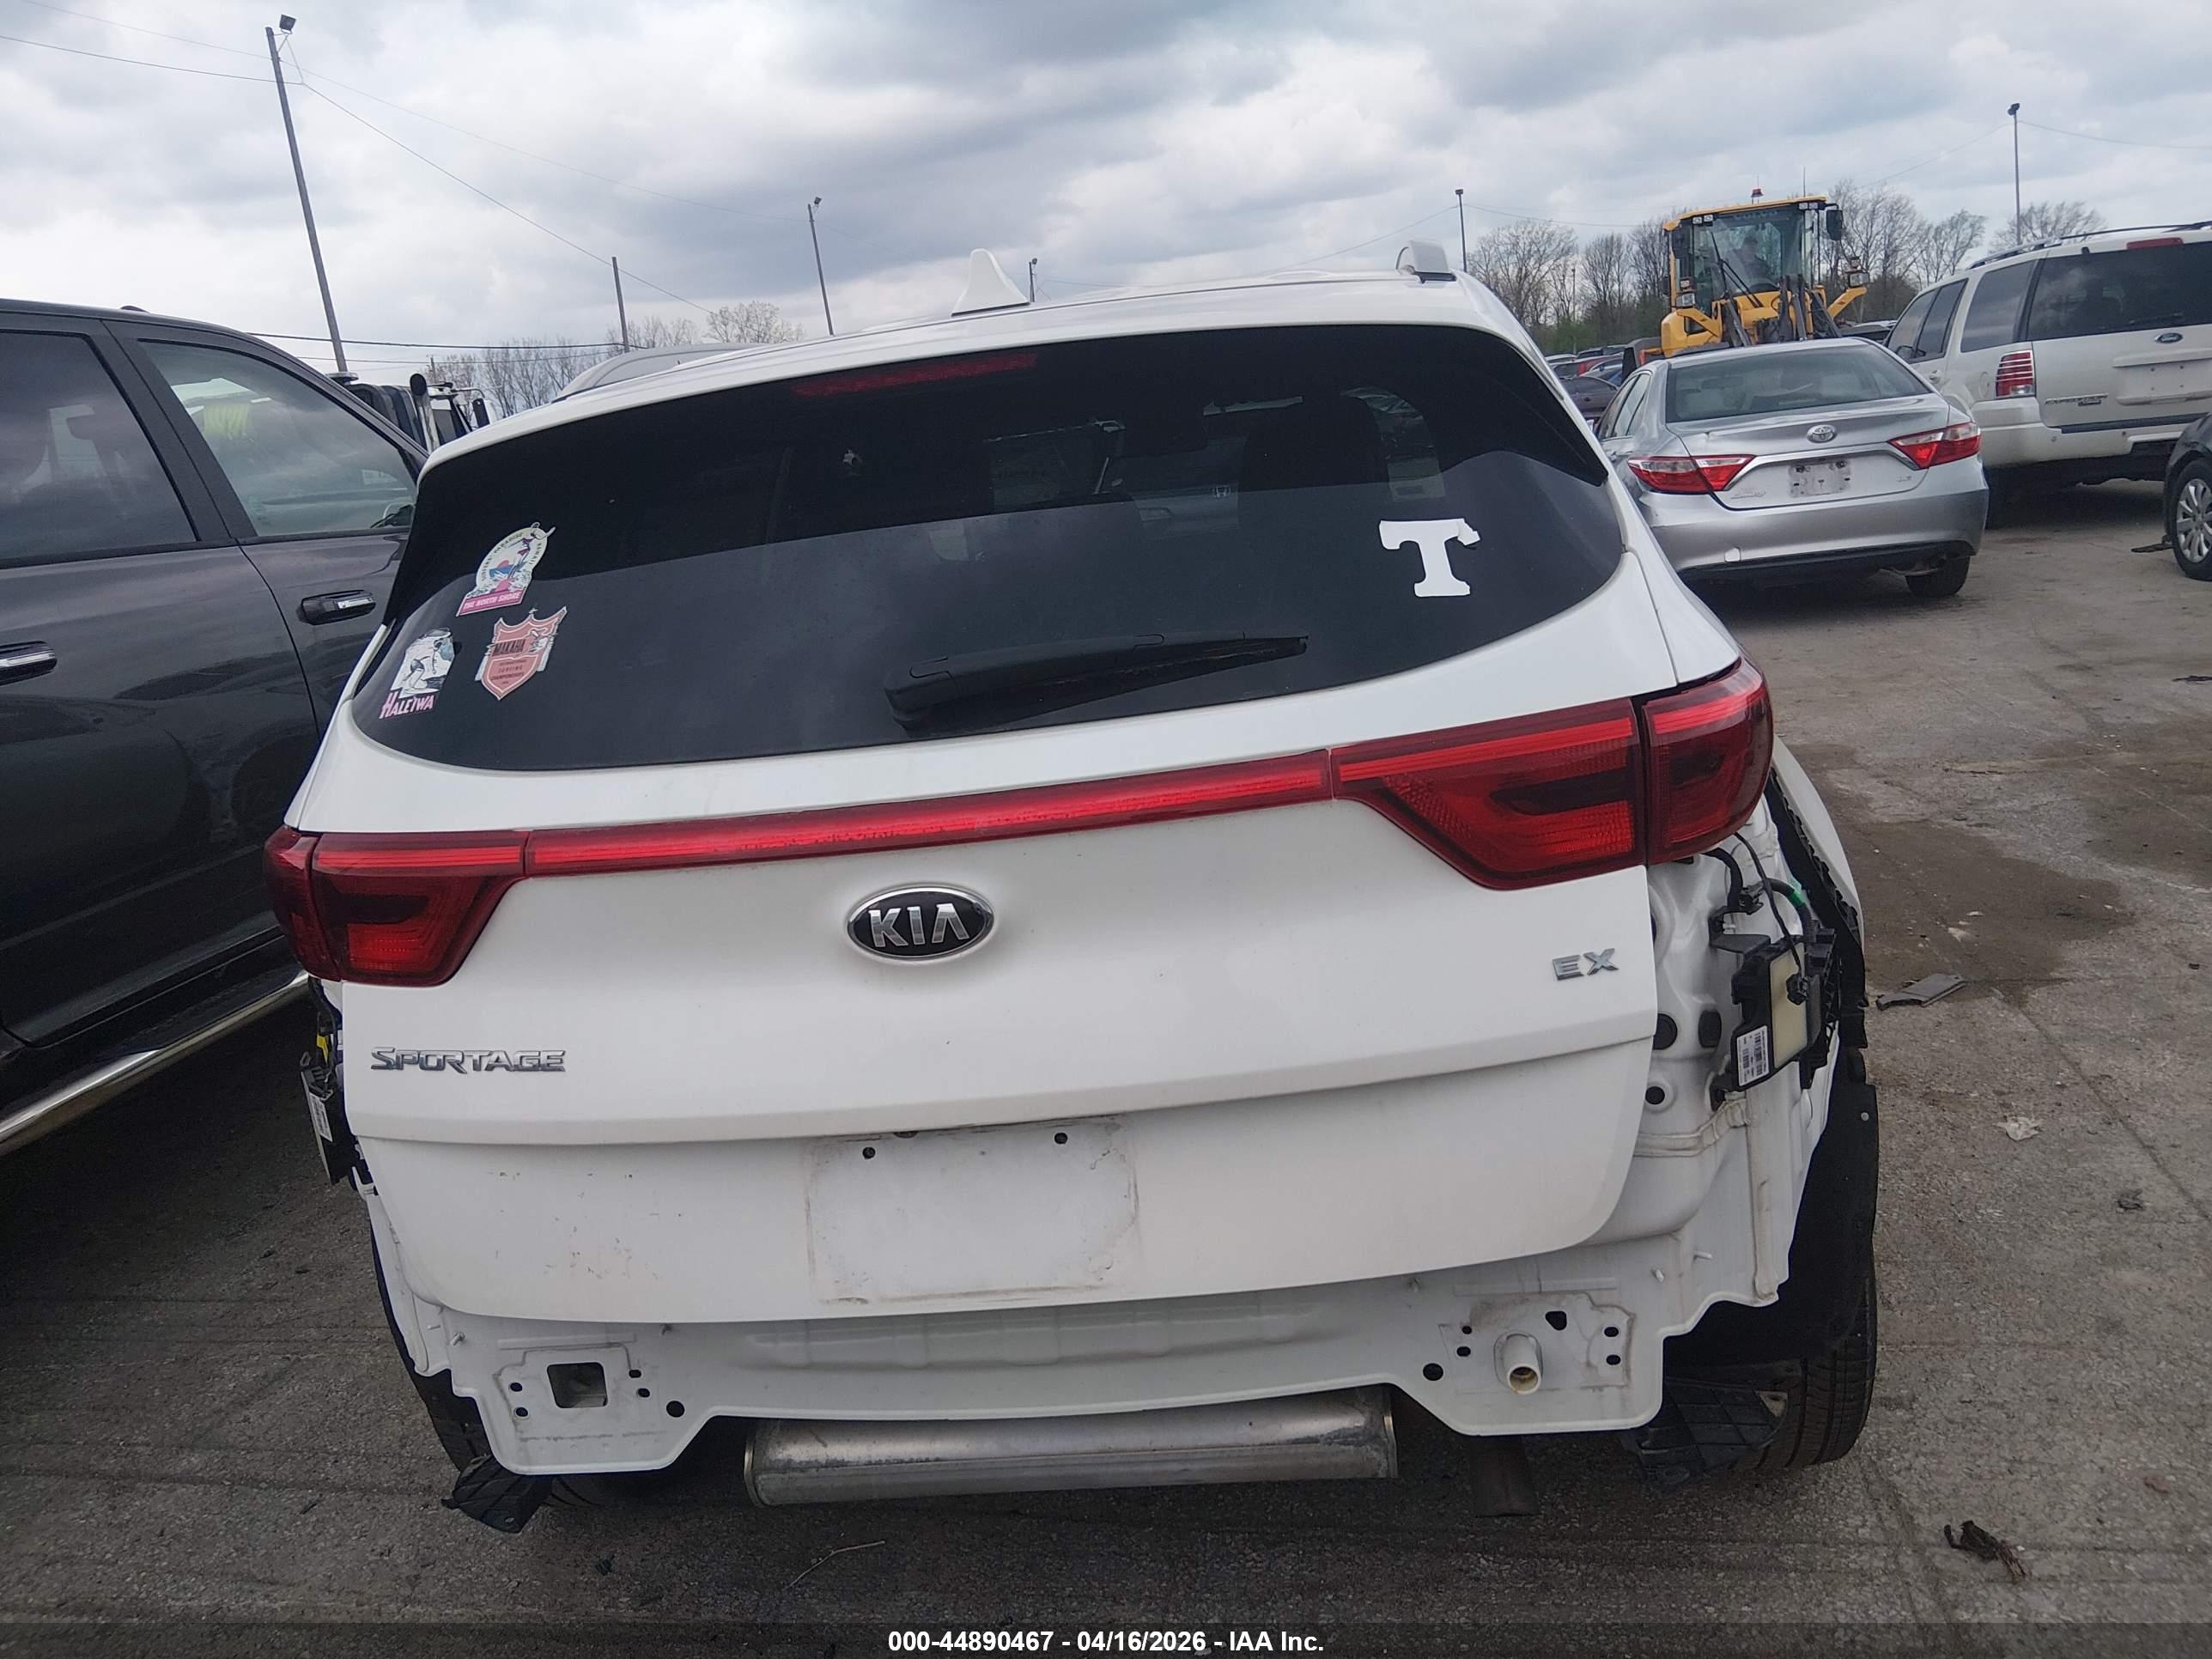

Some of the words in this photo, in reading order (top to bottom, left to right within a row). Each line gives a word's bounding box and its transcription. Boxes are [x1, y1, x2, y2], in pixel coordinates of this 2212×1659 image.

[1379, 518, 1480, 597] T
[477, 596, 498, 607] NORTH
[498, 592, 521, 603] SHORE
[868, 902, 970, 948] KIA
[1552, 948, 1619, 981] EX
[371, 1046, 566, 1074] SPORTAGE
